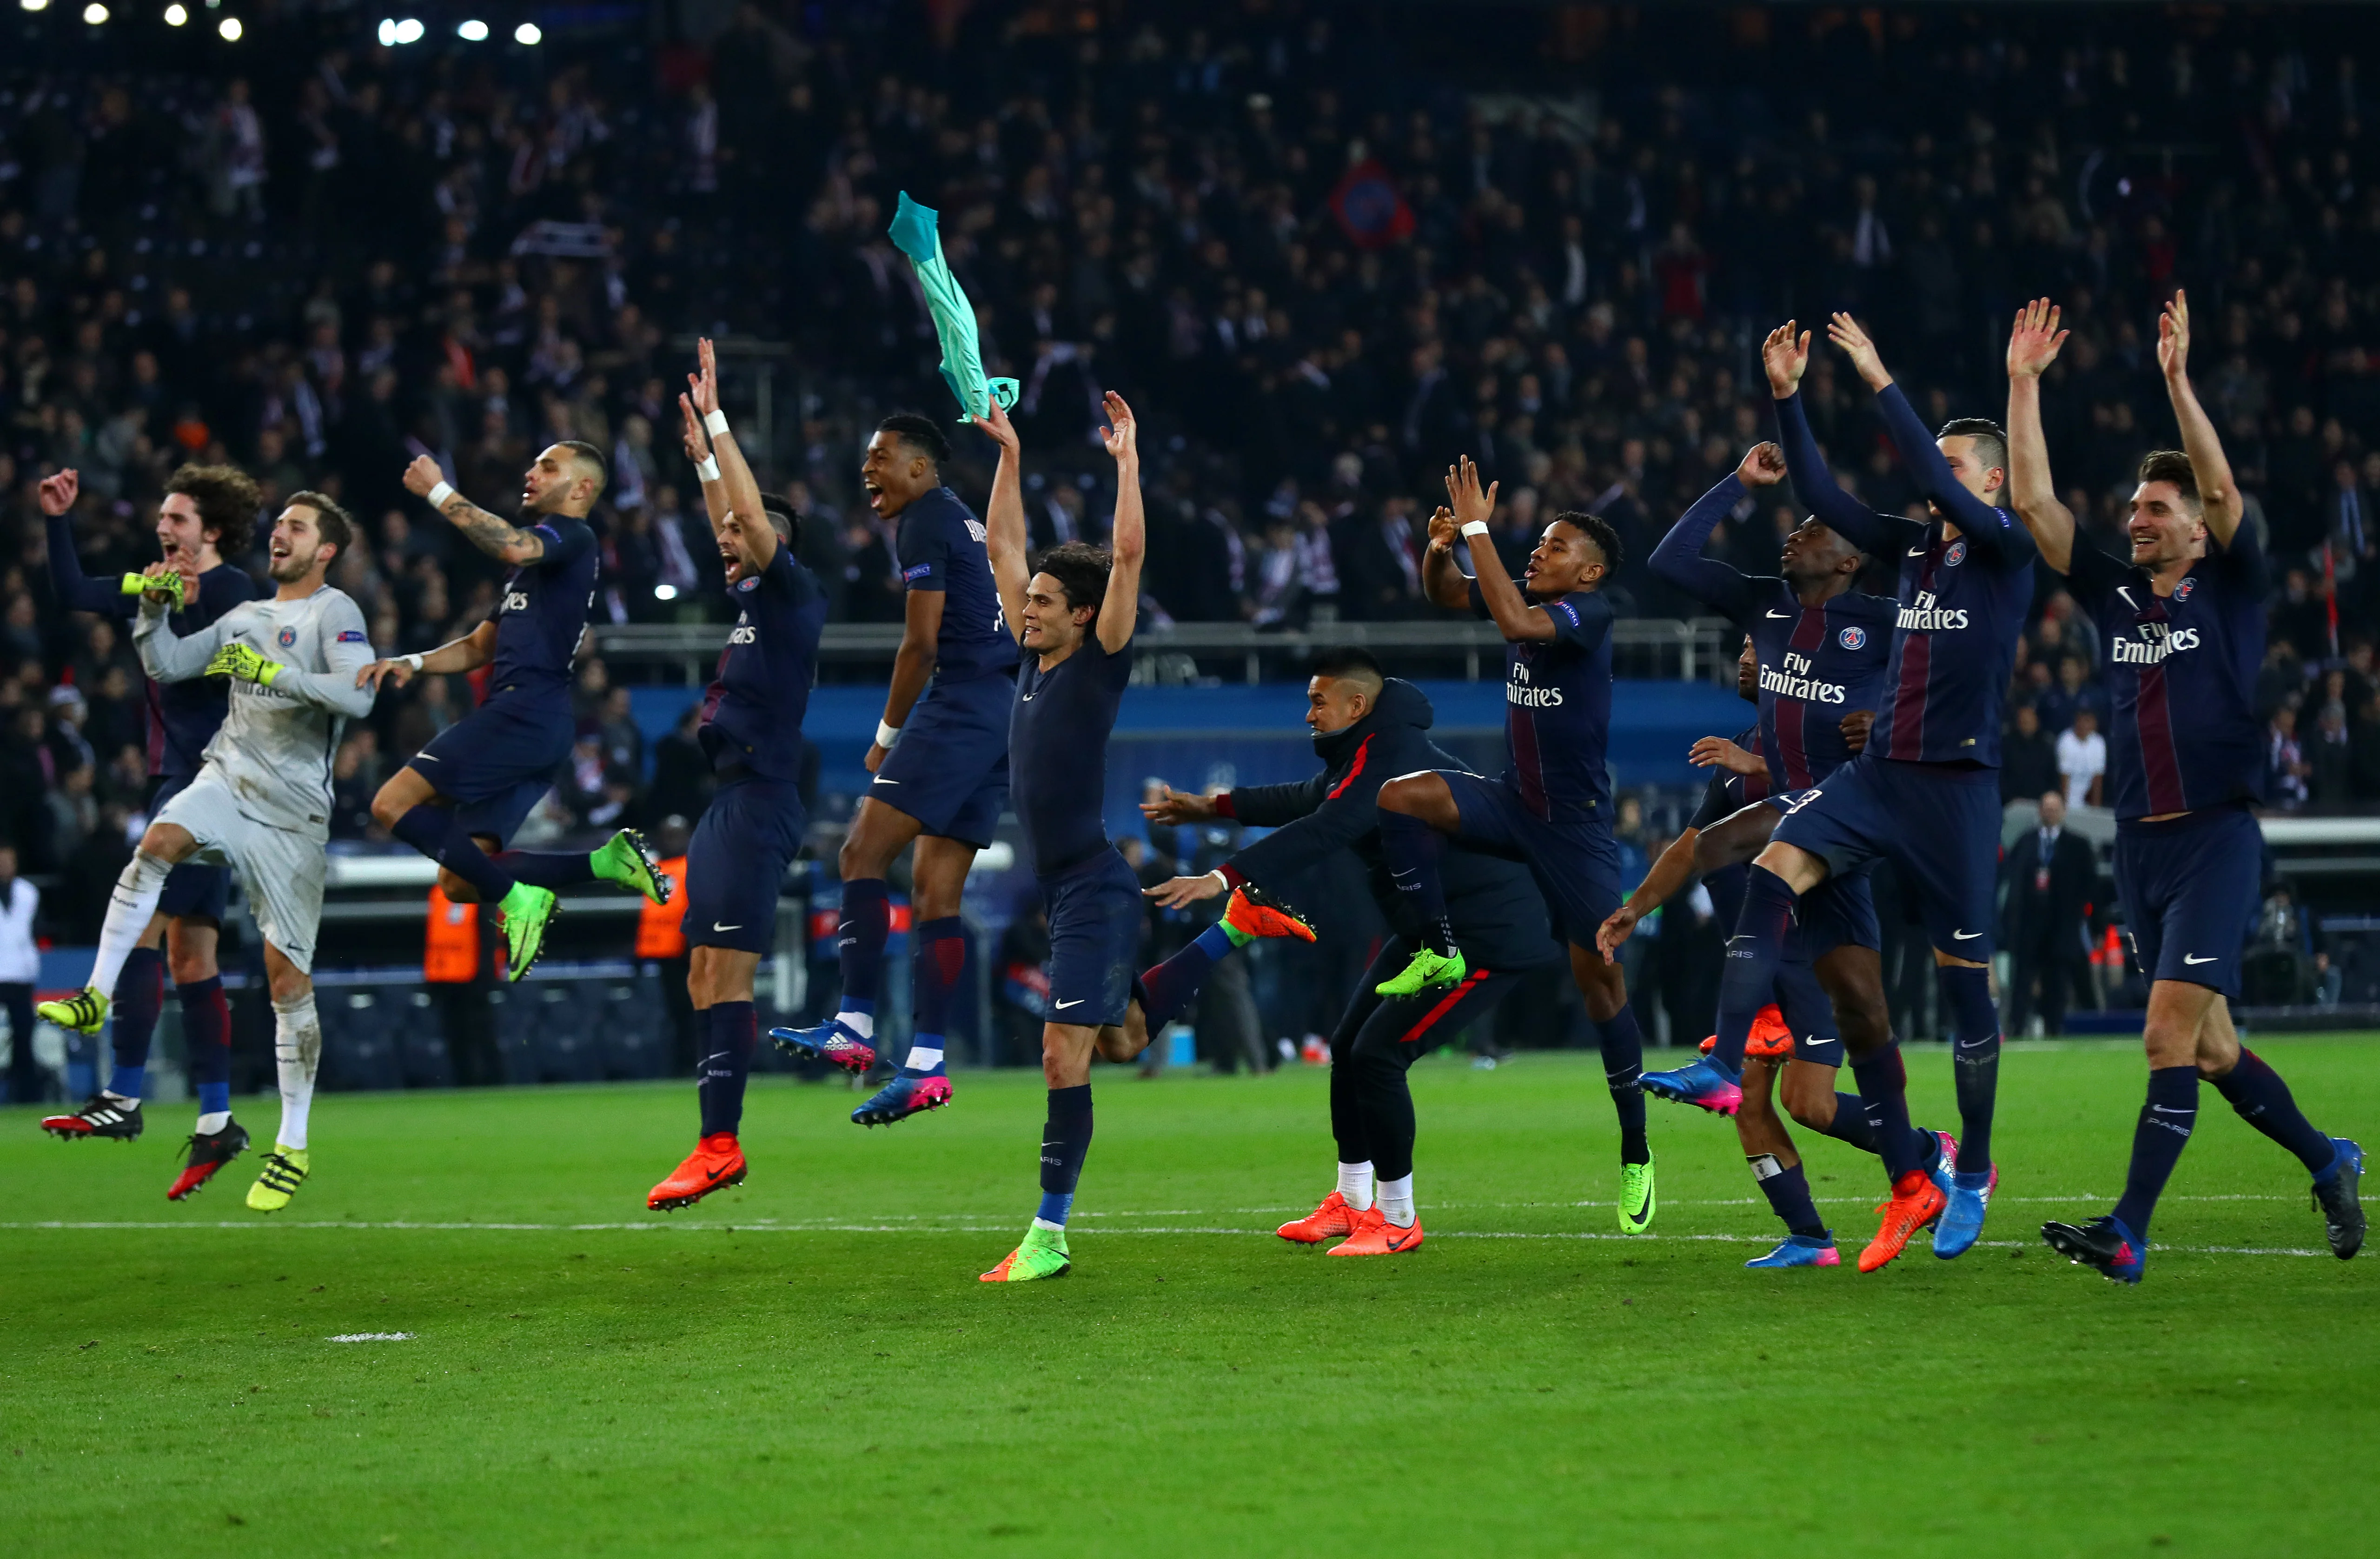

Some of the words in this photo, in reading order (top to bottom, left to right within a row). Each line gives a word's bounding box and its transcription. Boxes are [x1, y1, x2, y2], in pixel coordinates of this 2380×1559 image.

[1563, 603, 1579, 626] RESPECT
[1897, 603, 1969, 629] mirates
[1513, 662, 1529, 684] Fly
[1783, 652, 1812, 676] Fly
[1506, 680, 1563, 707] mirates
[1759, 664, 1845, 704] Emirates
[1396, 883, 1422, 891] ARIS
[824, 1043, 854, 1051] adidas
[1956, 1053, 1998, 1066] PARIS
[2147, 1117, 2190, 1137] PARIS
[1040, 1156, 1062, 1166] ARIS
